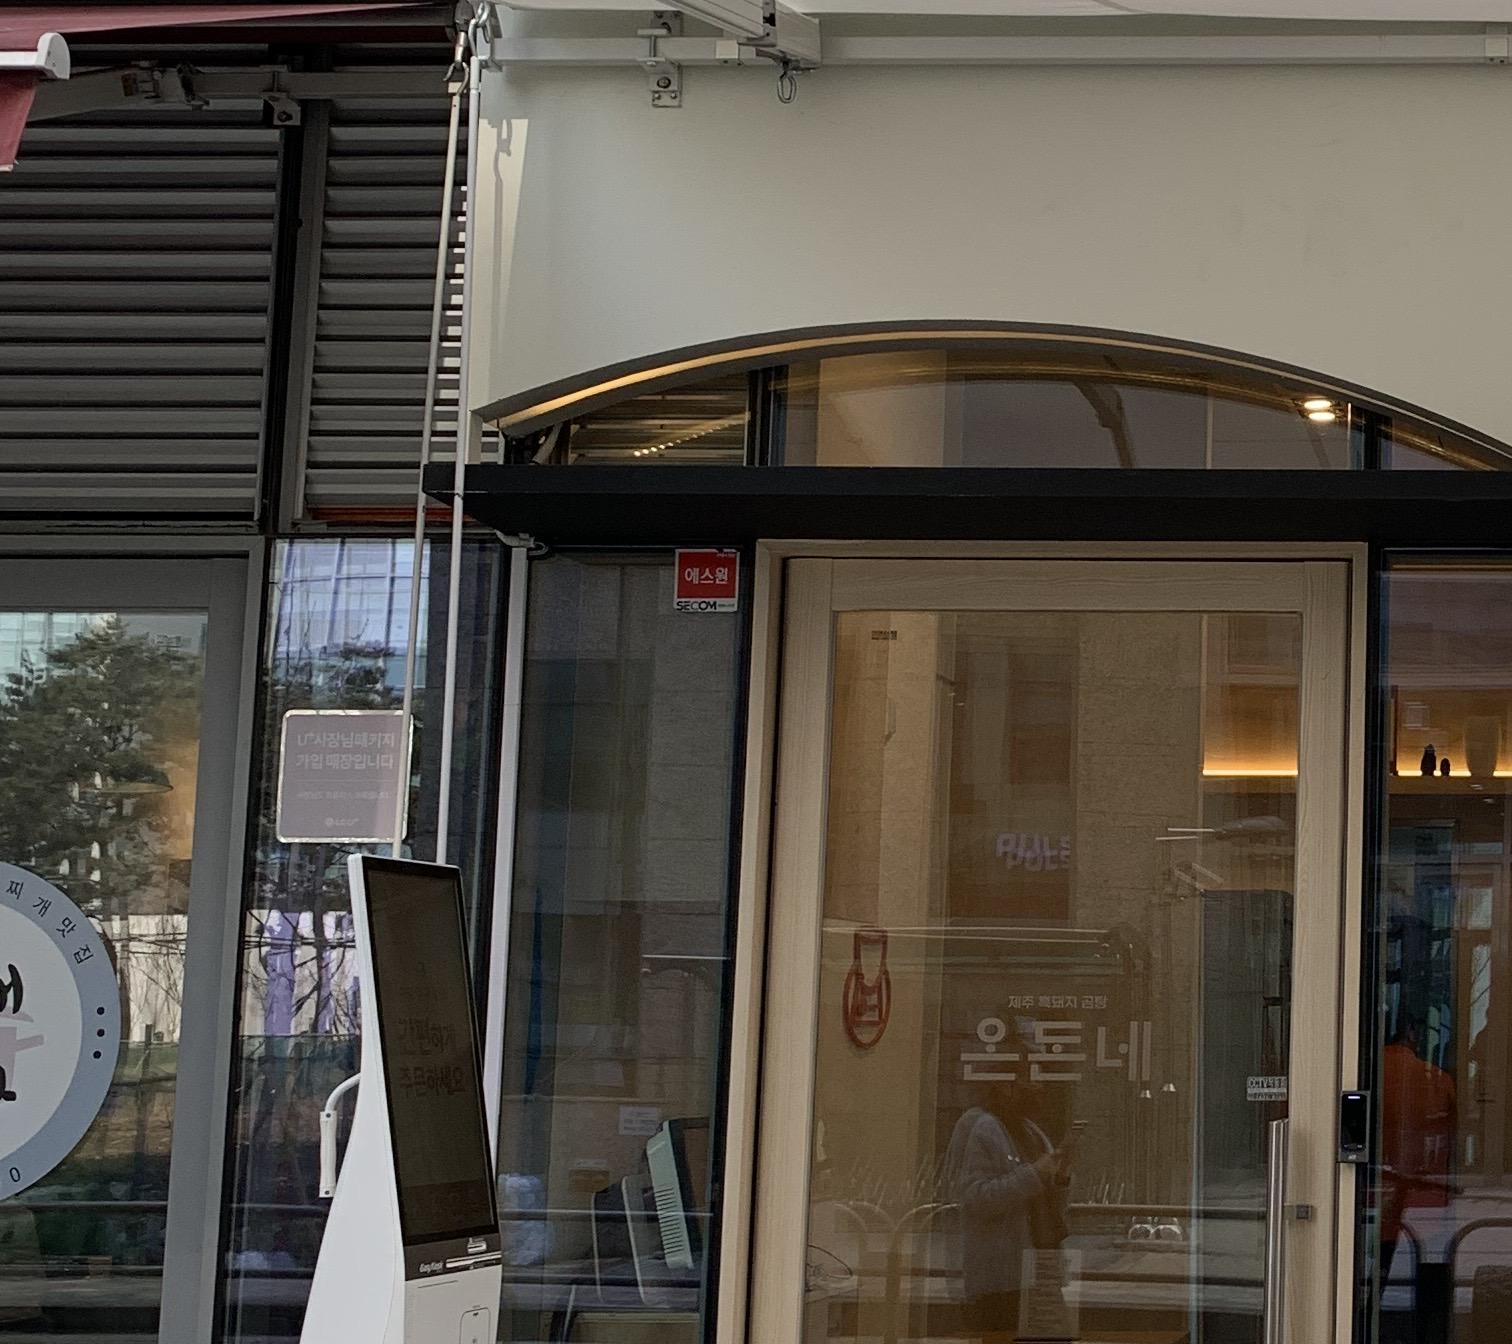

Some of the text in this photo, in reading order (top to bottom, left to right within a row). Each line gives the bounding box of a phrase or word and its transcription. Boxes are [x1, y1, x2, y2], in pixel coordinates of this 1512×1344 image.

[684, 567, 729, 585] 에스원
[676, 600, 717, 611] SECOM
[1008, 995, 1108, 1009] 제주 흑돼지 곰탕
[960, 1017, 1151, 1081] 온돈네
